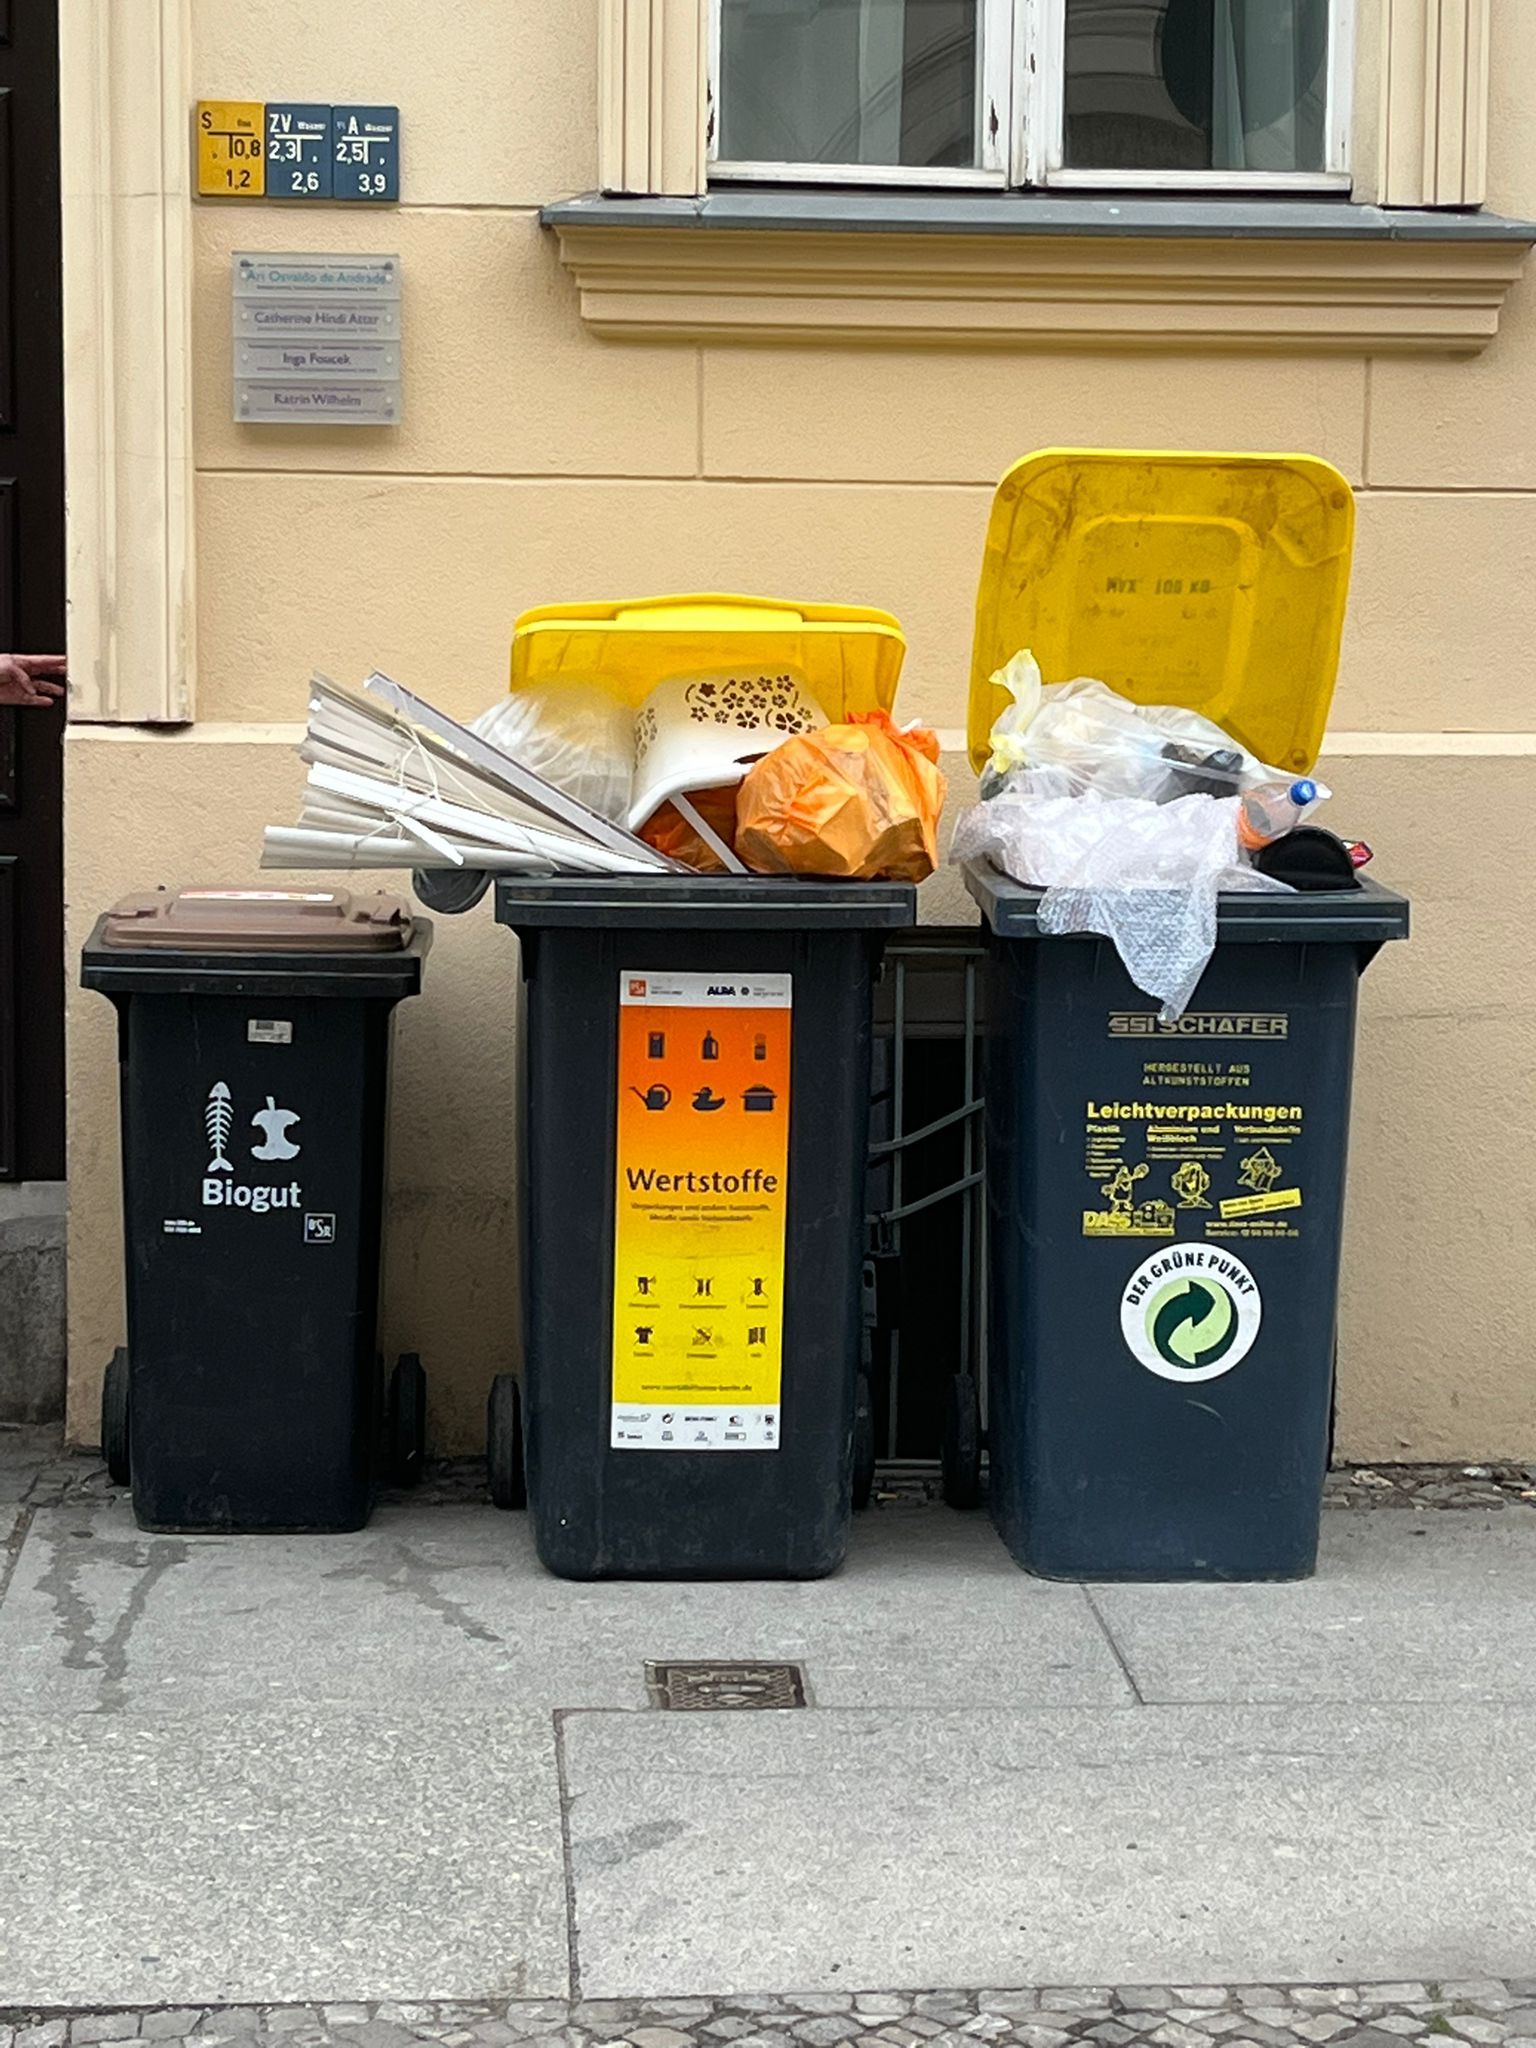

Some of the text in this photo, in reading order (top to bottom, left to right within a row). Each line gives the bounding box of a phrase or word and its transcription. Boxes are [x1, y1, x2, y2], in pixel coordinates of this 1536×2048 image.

[202, 112, 212, 129] S
[269, 114, 292, 133] ZV
[348, 115, 359, 135] A
[234, 139, 261, 159] 0,8
[269, 141, 296, 162] 2,3
[336, 143, 363, 164] 2,5
[226, 169, 251, 190] 1,2
[291, 172, 319, 193] 2,6
[358, 174, 386, 195] 3,9
[255, 312, 312, 324] Catherine
[315, 312, 346, 324] Hindi
[282, 352, 306, 367] Inga
[274, 393, 361, 406] Katrin Wilhelm
[1108, 1017, 1154, 1034] SSI
[1143, 1062, 1251, 1075] HERGESTELLT AUS
[1142, 1075, 1250, 1087] ALTKUNSTSTOFFEN
[1087, 1101, 1303, 1122] Leichtverpackungen
[626, 1167, 778, 1193] Wertstoffe
[202, 1178, 302, 1213] Biogut
[1126, 1251, 1255, 1306] DER GRÜNE PUNKT
